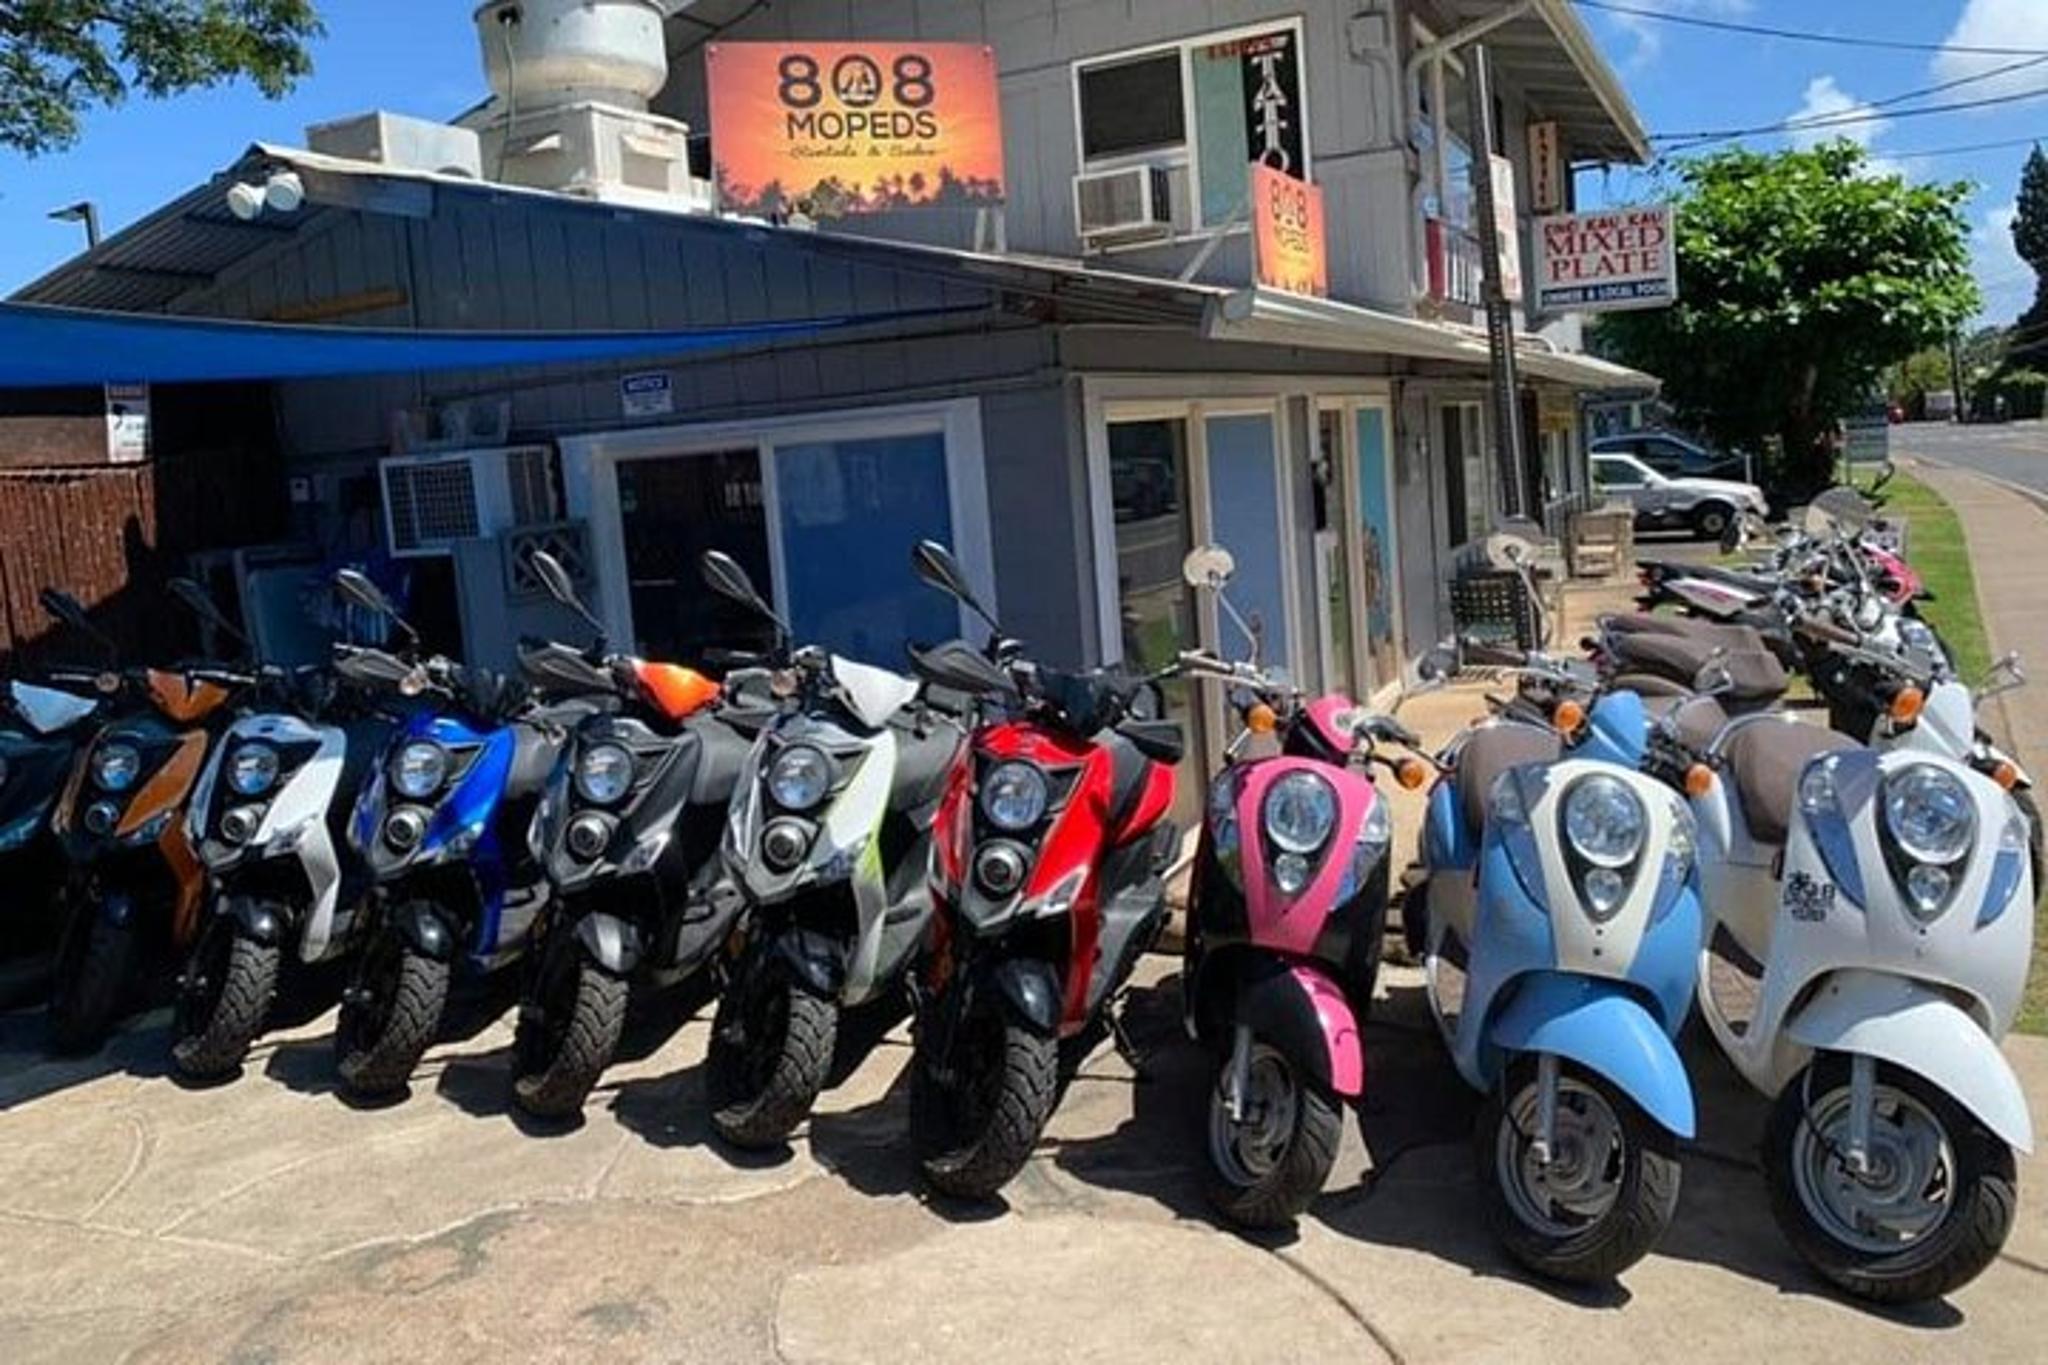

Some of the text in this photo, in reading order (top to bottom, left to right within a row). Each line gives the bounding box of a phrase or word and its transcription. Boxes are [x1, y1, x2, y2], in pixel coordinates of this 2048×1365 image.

[778, 54, 935, 108] 808
[787, 111, 938, 140] MOPEDS
[1270, 178, 1309, 229] 808
[1545, 226, 1665, 257] MIXED
[1551, 249, 1660, 282] PLATE
